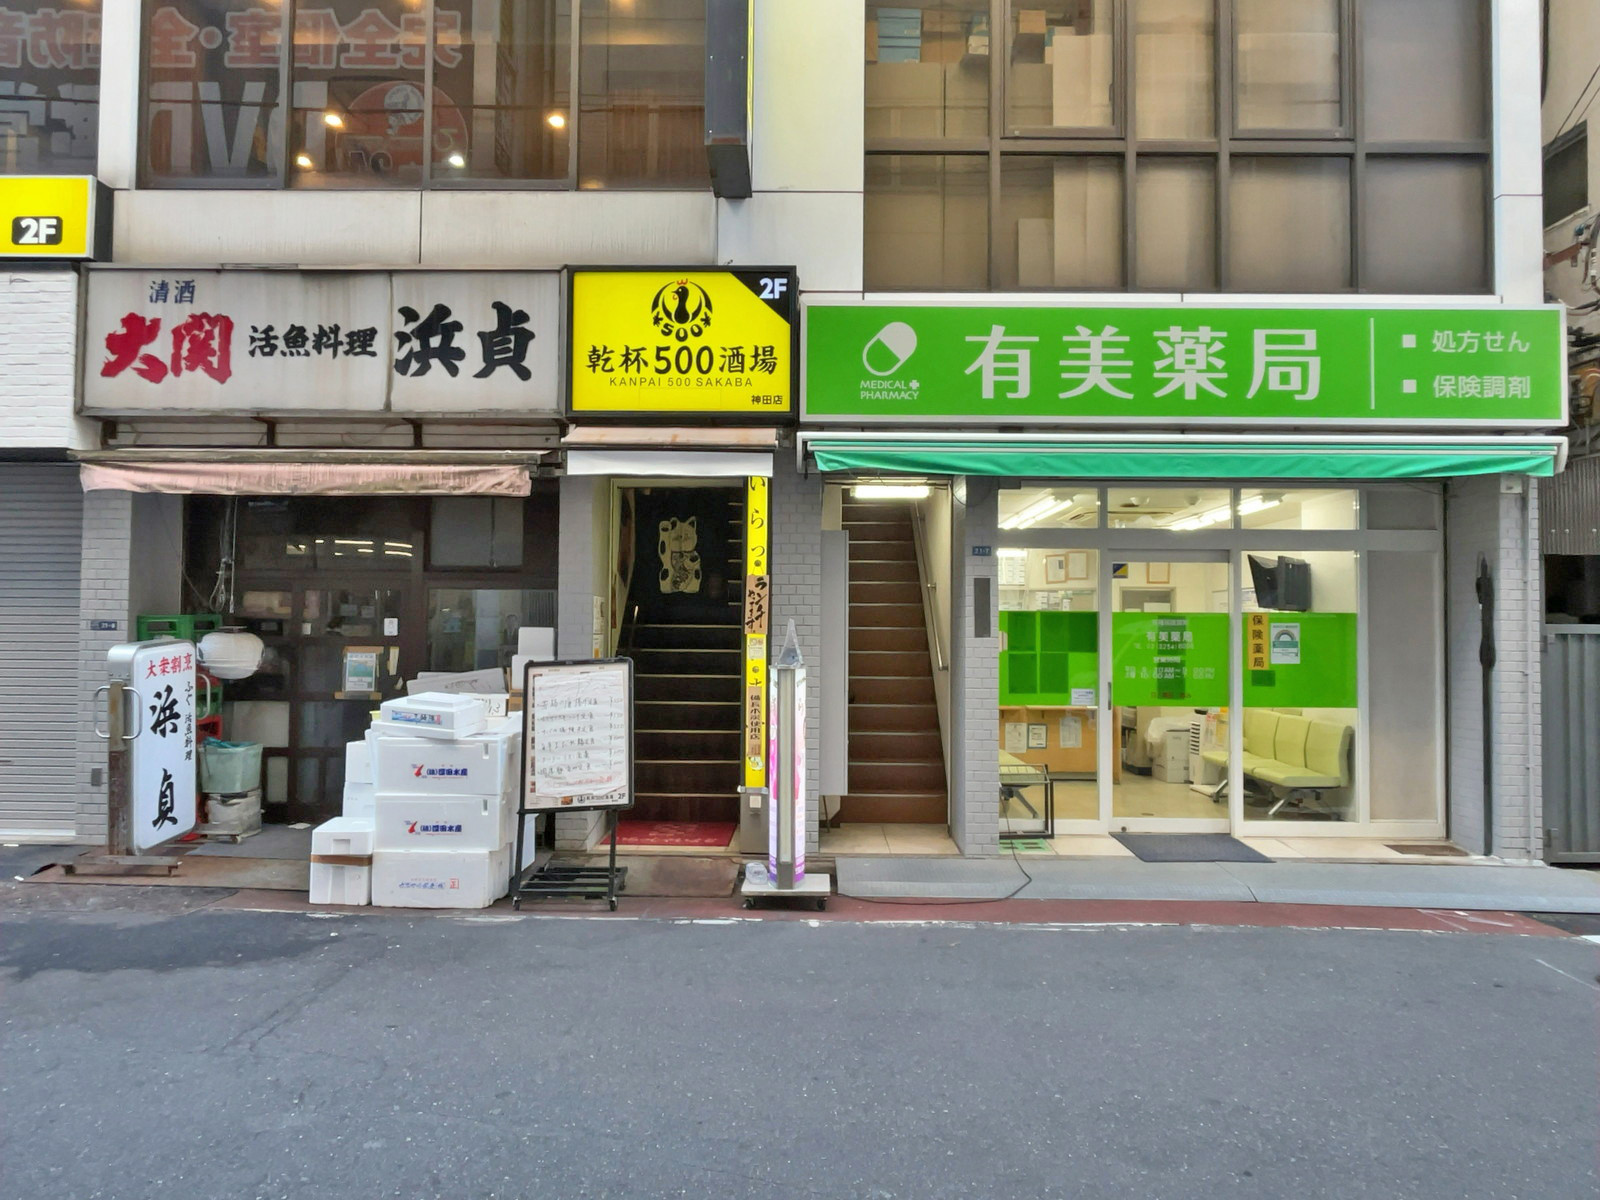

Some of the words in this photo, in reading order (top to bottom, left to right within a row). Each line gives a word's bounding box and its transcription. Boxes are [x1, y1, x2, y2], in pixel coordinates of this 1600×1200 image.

[18, 217, 58, 244] 2F
[148, 278, 196, 304] 清酒
[758, 277, 788, 300] 2F
[100, 311, 235, 384] 大関
[247, 323, 378, 360] 活魚料理
[394, 301, 537, 382] 浜貞
[1432, 329, 1531, 354] 処方せん
[585, 344, 779, 375] 乾杯500酒場
[964, 323, 1321, 402] 有美薬局
[609, 376, 662, 387] KANPAI
[667, 376, 692, 387] 500
[695, 376, 754, 387] SAKABA
[860, 380, 907, 389] MEDICAL
[860, 390, 919, 400] PHARMACY
[1432, 375, 1531, 399] 保険調剤
[751, 394, 783, 406] 神田店
[1252, 615, 1264, 668] 保険薬局
[145, 653, 193, 680] 大衆割烹
[149, 684, 182, 831] 浜貞
